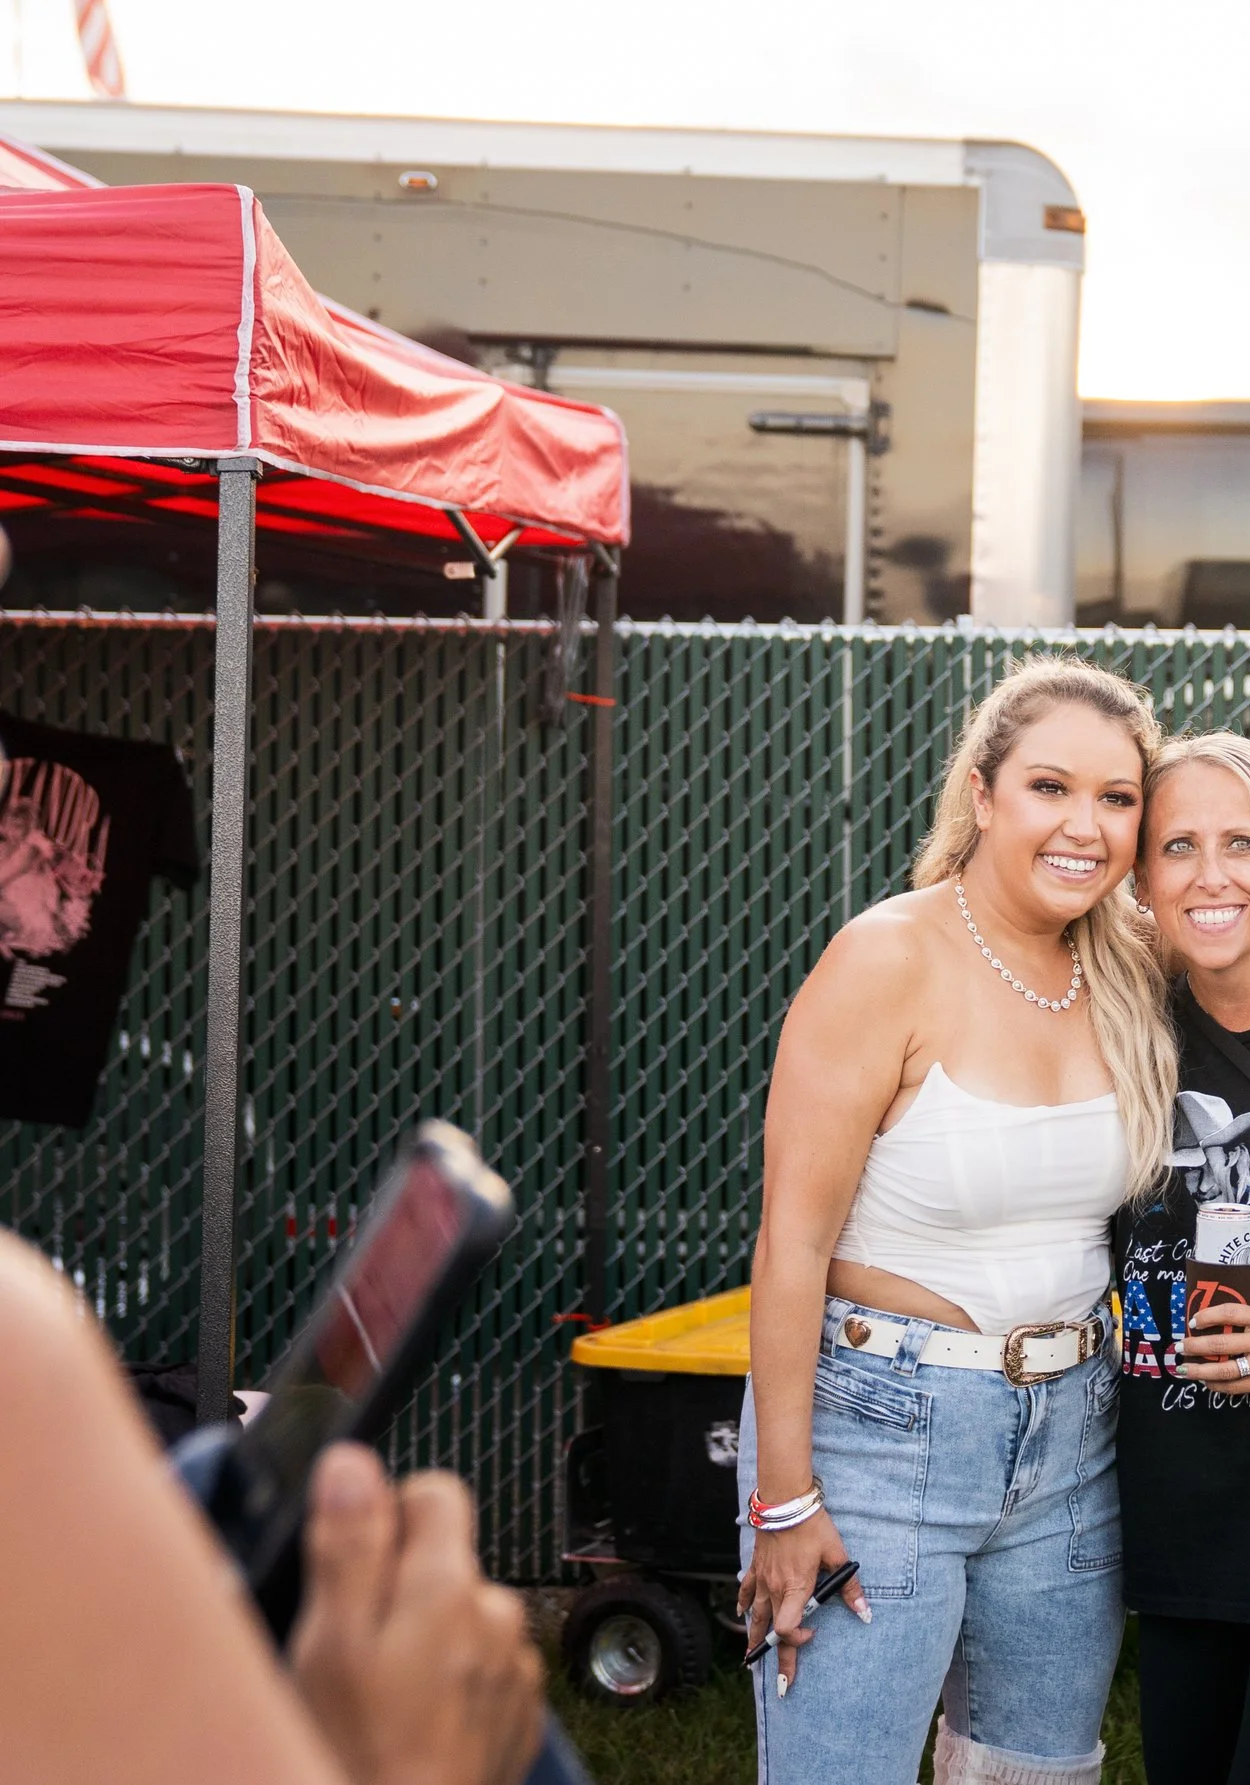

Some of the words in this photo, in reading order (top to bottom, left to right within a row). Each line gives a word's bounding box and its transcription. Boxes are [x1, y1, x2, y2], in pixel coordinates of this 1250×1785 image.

[1126, 1238, 1172, 1263] Last
[1172, 1238, 1197, 1259] Cal
[1219, 1237, 1242, 1264] HITE
[1123, 1261, 1149, 1281] One
[1157, 1270, 1186, 1281] mo
[1162, 1383, 1198, 1411] US
